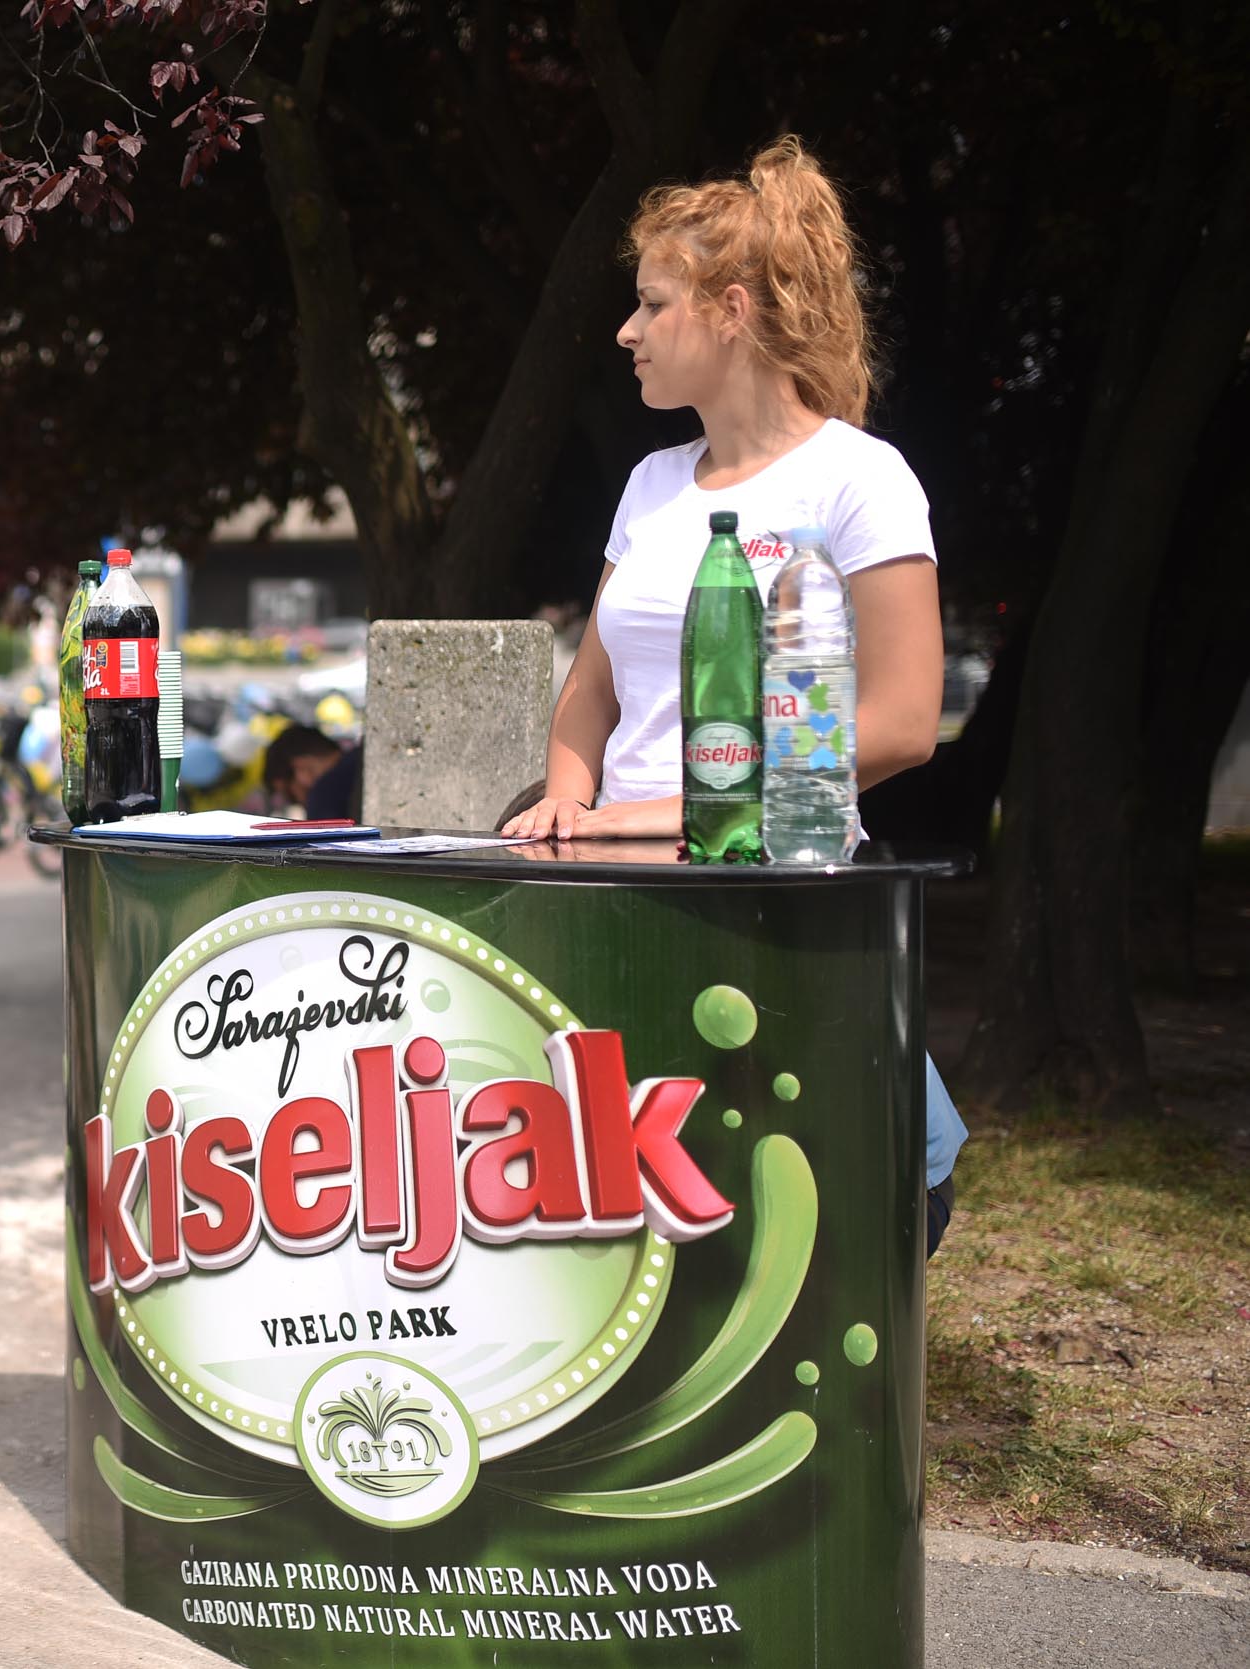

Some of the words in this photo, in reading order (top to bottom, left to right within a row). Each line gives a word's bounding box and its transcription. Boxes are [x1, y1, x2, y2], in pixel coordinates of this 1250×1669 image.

[174, 935, 410, 1099] Sarajevski
[83, 1029, 735, 1292] kiseljak
[260, 1311, 358, 1348] VRELO
[366, 1305, 458, 1341] PARK
[180, 1560, 280, 1589] GAZIRANA
[283, 1562, 421, 1595] PRIRODNA
[425, 1565, 618, 1598] MINERALNA
[620, 1559, 718, 1595] VODA
[182, 1598, 317, 1631] CARBONATED
[321, 1604, 456, 1638] NATURAL
[461, 1608, 612, 1642] MINERAL
[615, 1603, 742, 1640] WATER
